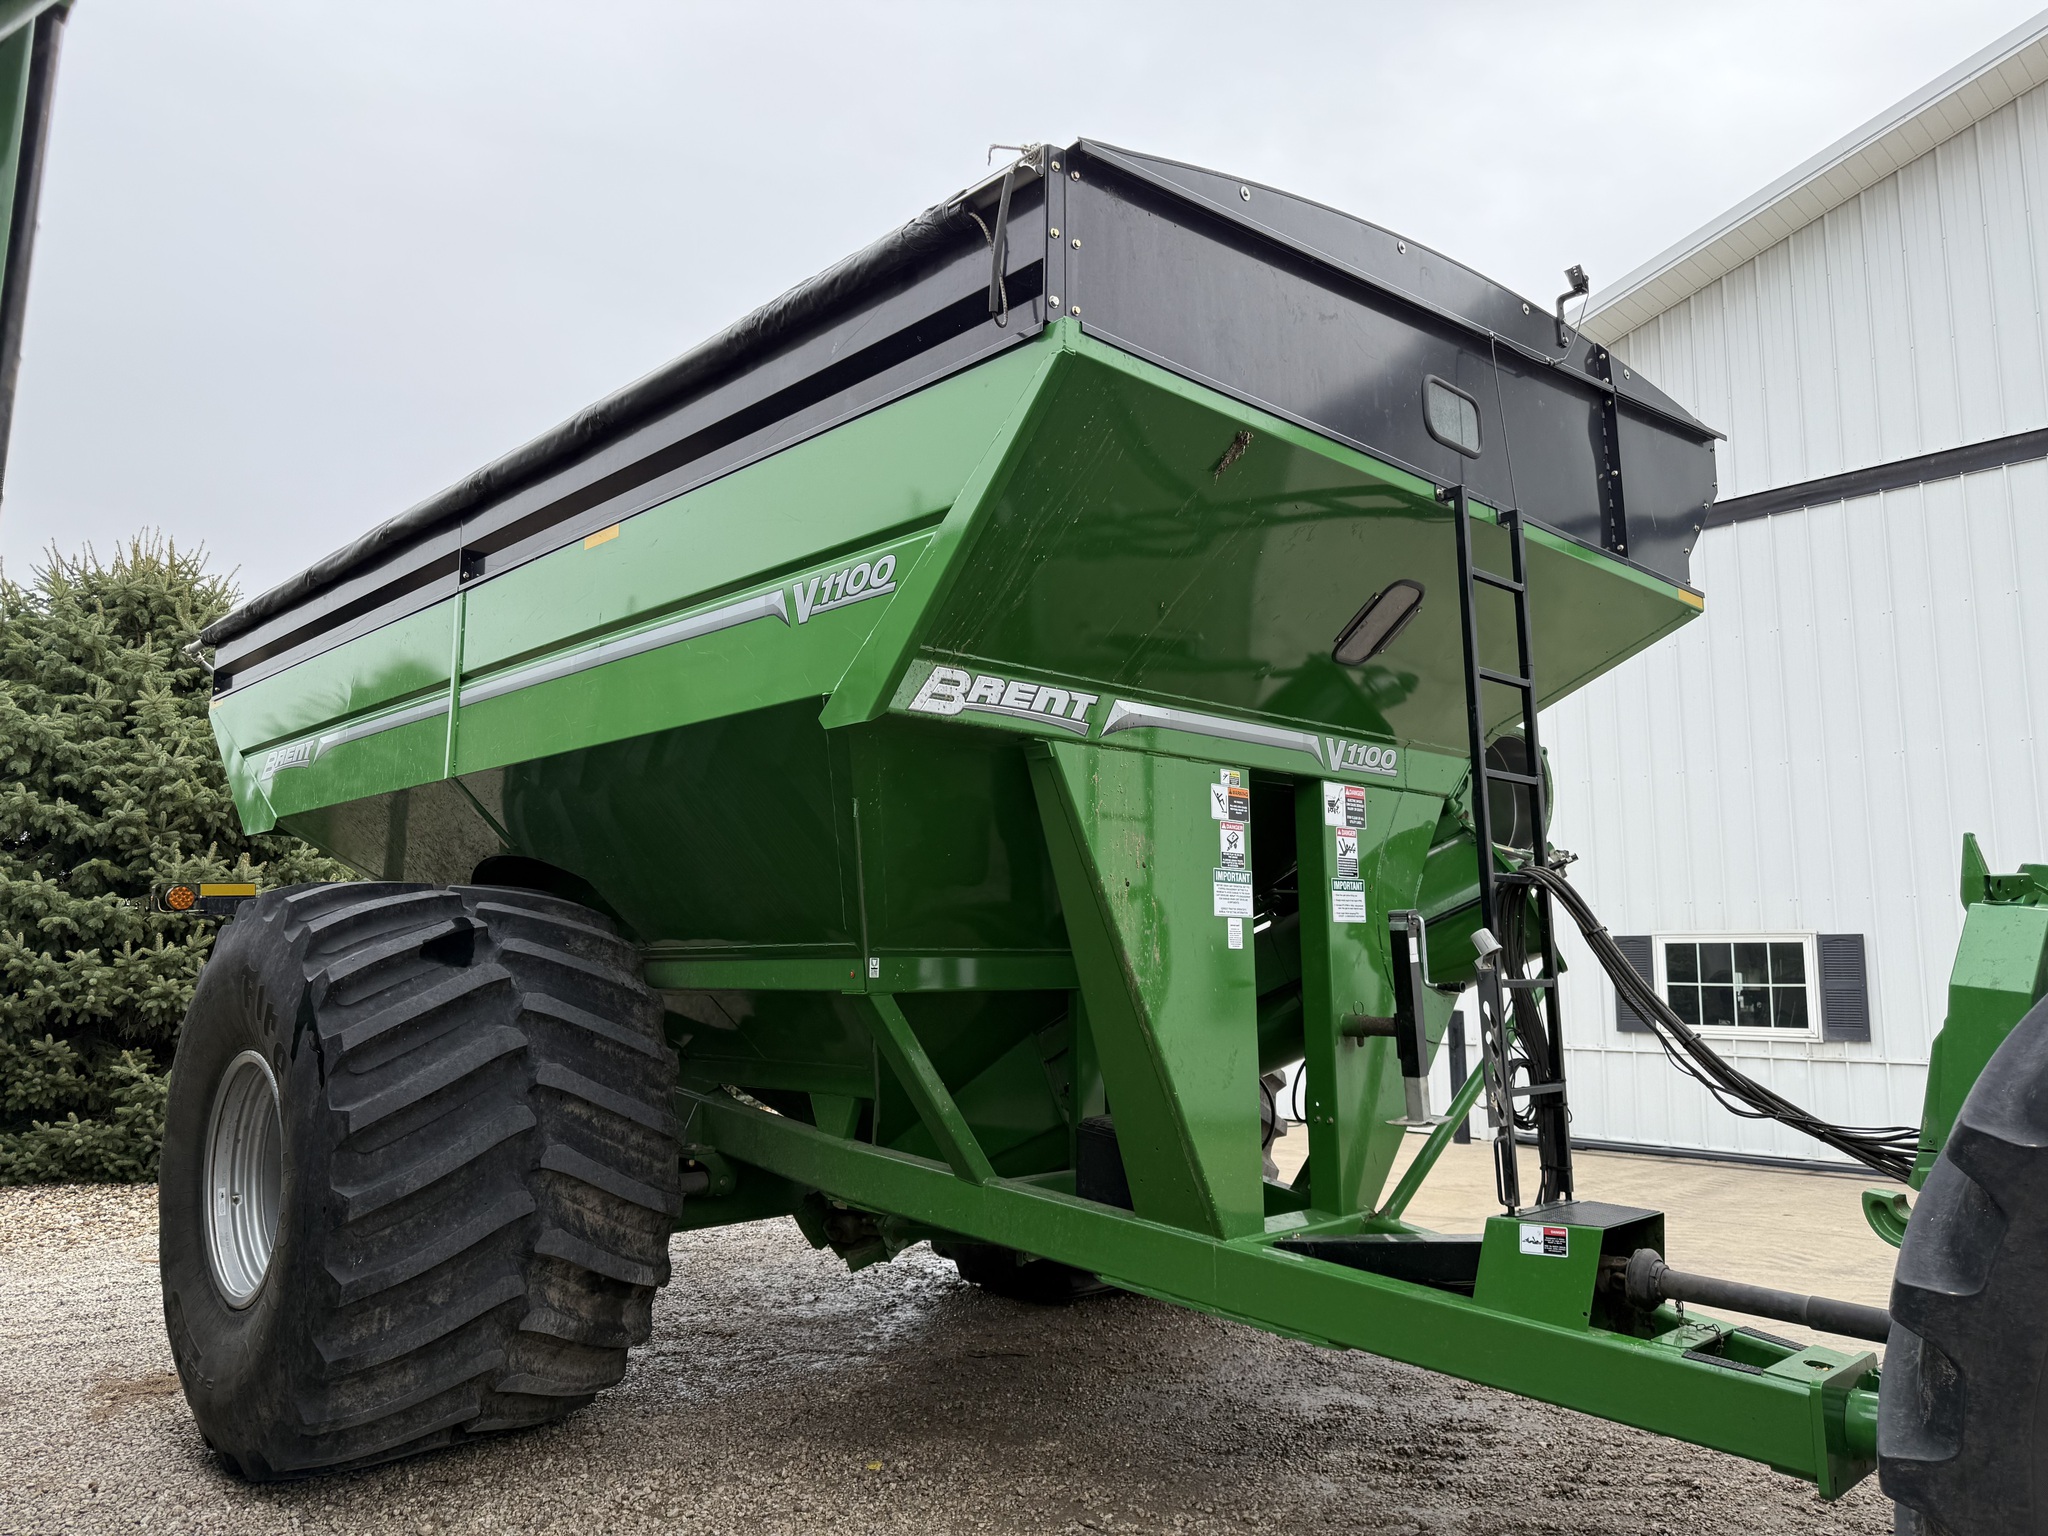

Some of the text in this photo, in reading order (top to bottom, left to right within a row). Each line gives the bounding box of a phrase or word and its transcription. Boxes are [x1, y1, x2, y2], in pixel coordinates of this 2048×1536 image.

[793, 554, 896, 624] V1100
[908, 666, 1098, 722] BRENT
[261, 740, 314, 781] BRENT
[1326, 737, 1397, 771] V1100
[1342, 829, 1356, 837] DANGER
[1215, 871, 1250, 883] IMPORTANT
[1333, 881, 1363, 891] IMPORTANT
